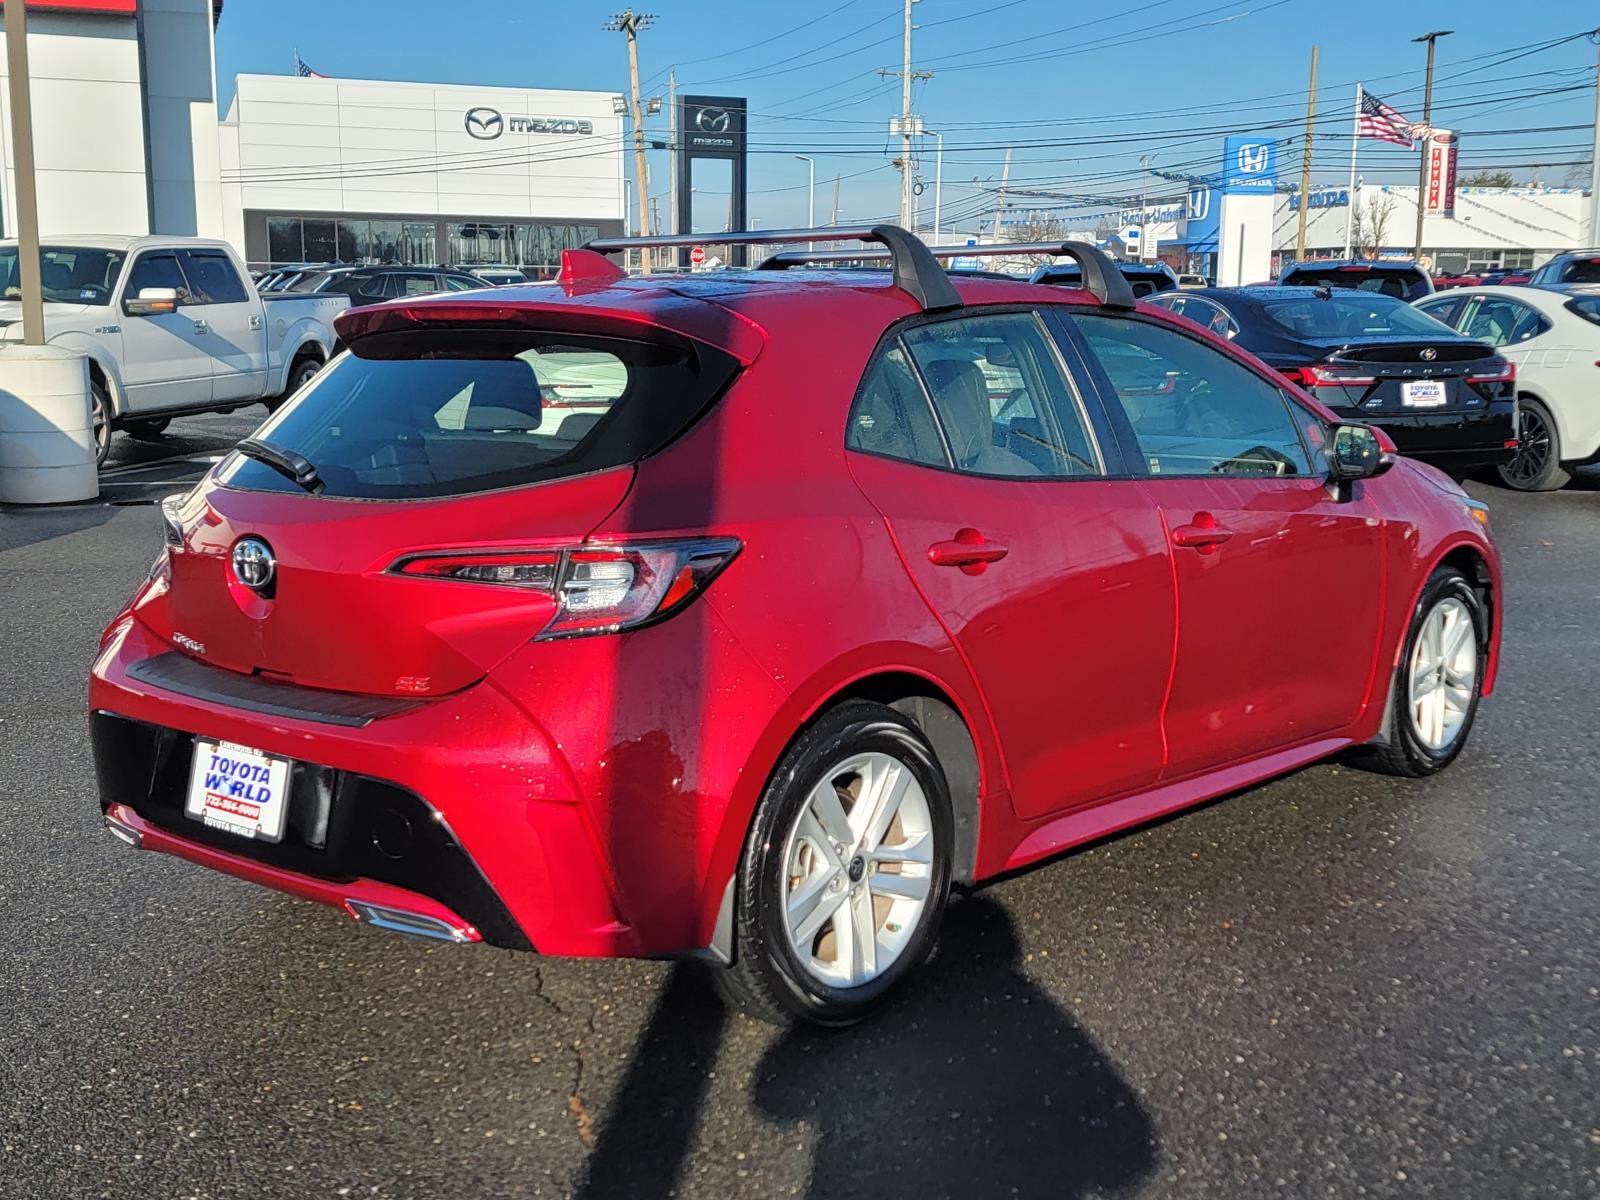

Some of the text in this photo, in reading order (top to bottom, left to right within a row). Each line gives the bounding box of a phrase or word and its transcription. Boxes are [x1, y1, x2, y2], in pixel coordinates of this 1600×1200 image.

[1229, 178, 1273, 187] HONDA
[1430, 149, 1440, 207] TOYOTA
[210, 755, 271, 785] TOYOTA
[204, 816, 230, 832] TOYOTA
